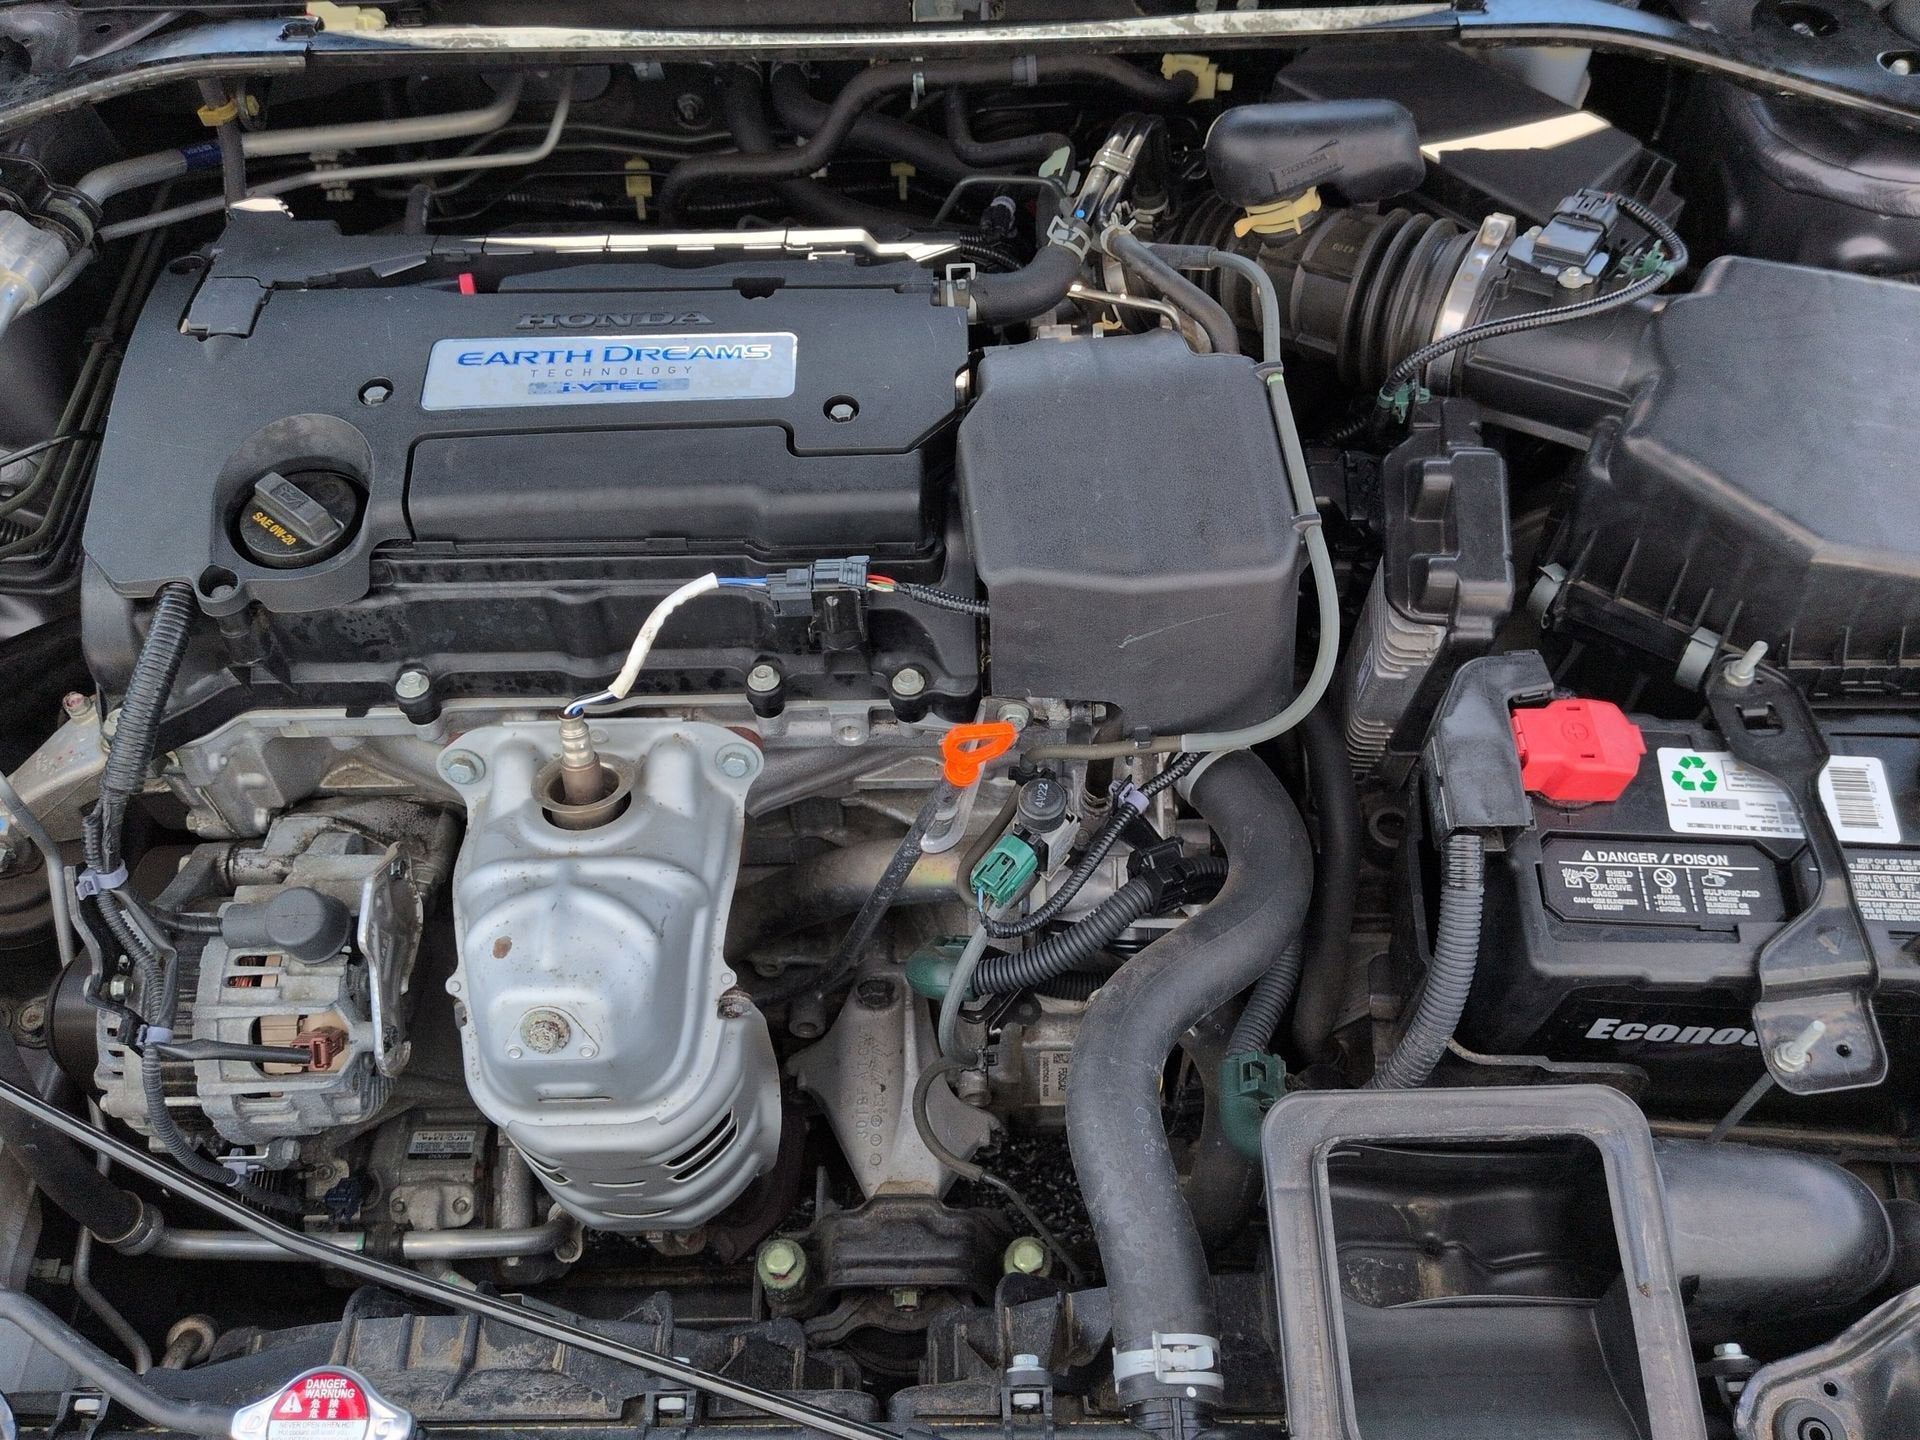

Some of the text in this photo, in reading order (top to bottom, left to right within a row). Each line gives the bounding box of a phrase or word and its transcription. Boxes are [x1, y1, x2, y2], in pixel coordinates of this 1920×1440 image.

[517, 311, 714, 330] HONDA
[458, 344, 772, 366] EARTH DREAMS
[530, 366, 693, 378] TECHNOLOGY
[562, 381, 658, 393] i-VTEC
[252, 511, 297, 546] SAE 0W-20
[1034, 783, 1048, 808] 4V22
[1597, 851, 1659, 863] DANGER
[1672, 853, 1729, 865] POISON
[1605, 870, 1633, 878] SHIELD
[1872, 875, 1893, 883] EYES
[1590, 883, 1633, 891] EXPLOSIVE
[1854, 882, 1869, 890] ITH
[1899, 883, 1915, 891] GET
[1591, 890, 1618, 898] GASES
[1703, 888, 1741, 897] SULFURIC
[1855, 889, 1885, 898] EDICAL
[1885, 890, 1905, 898] HELP
[306, 1379, 347, 1388] DANGER
[305, 1388, 356, 1399] WARNUNG
